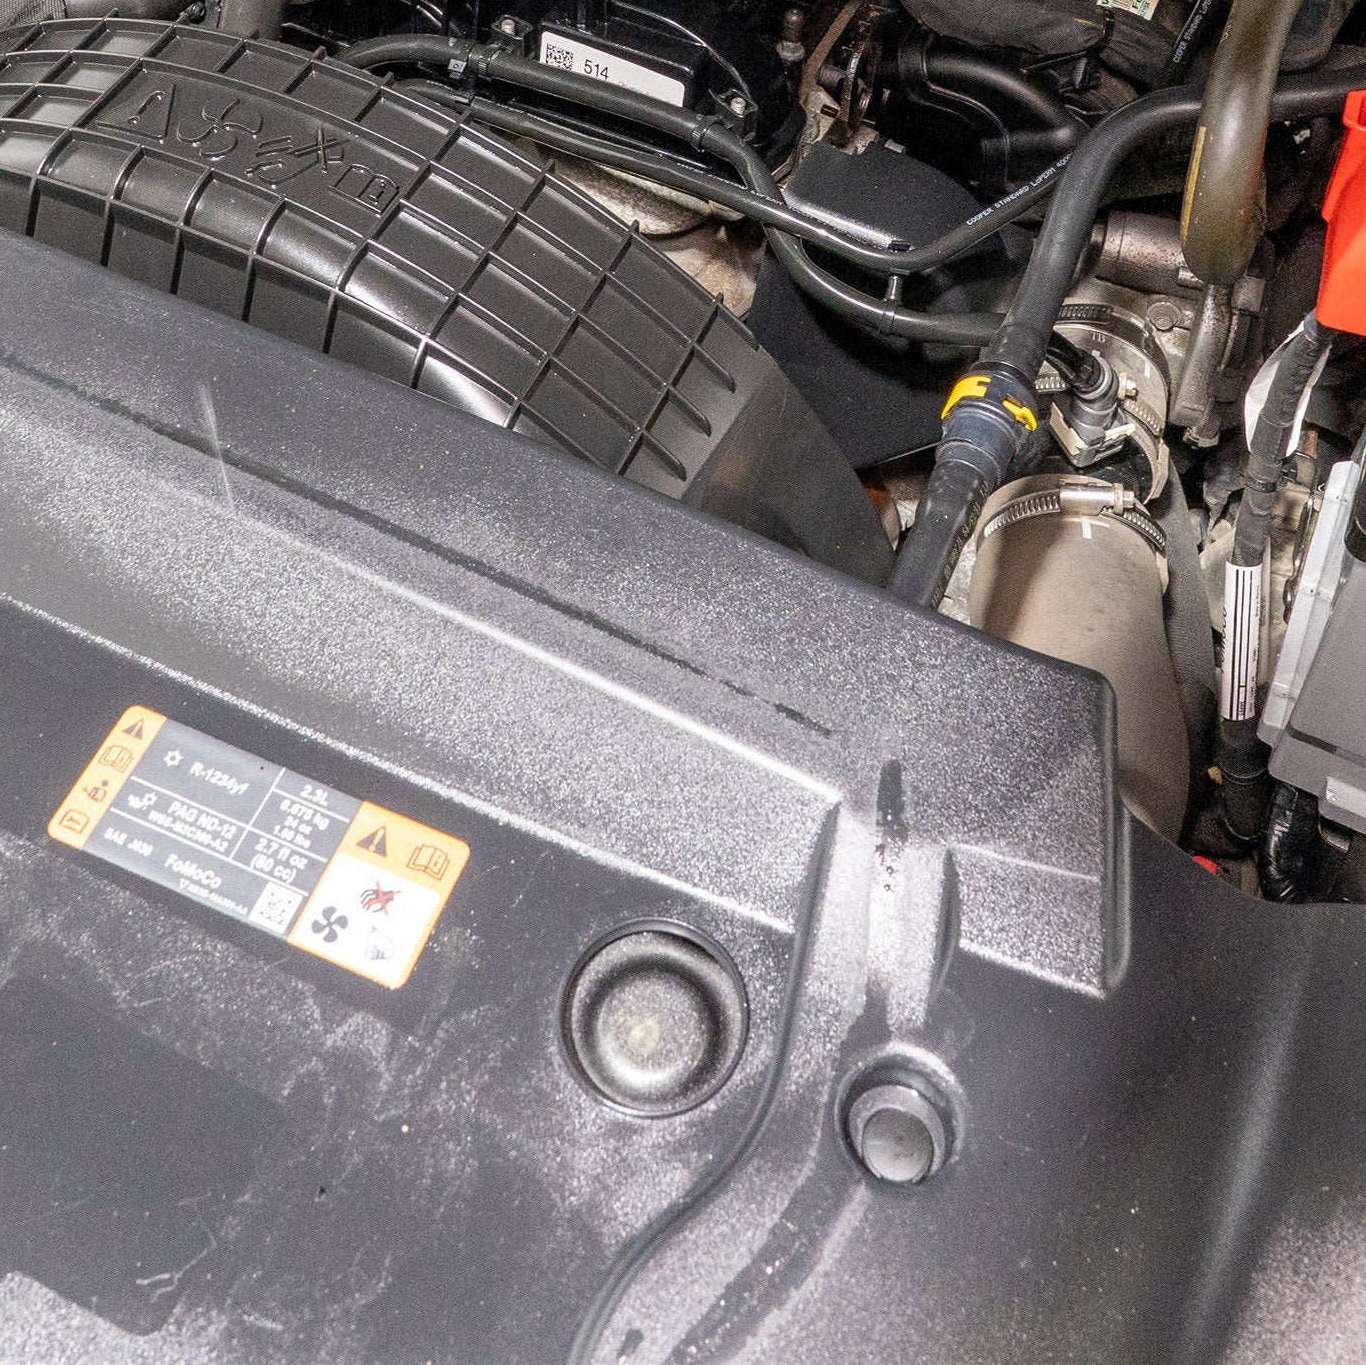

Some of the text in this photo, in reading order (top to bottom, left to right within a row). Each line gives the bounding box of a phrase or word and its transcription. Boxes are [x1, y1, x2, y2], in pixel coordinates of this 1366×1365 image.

[581, 58, 612, 81] 514
[964, 205, 994, 227] COOPER
[993, 183, 1030, 209] STANDARD
[189, 761, 248, 797] R-1234yf
[299, 783, 331, 806] 2.3L
[167, 800, 198, 823] PAG
[253, 835, 279, 857] 2.7
[164, 853, 223, 888] FoMoCo
